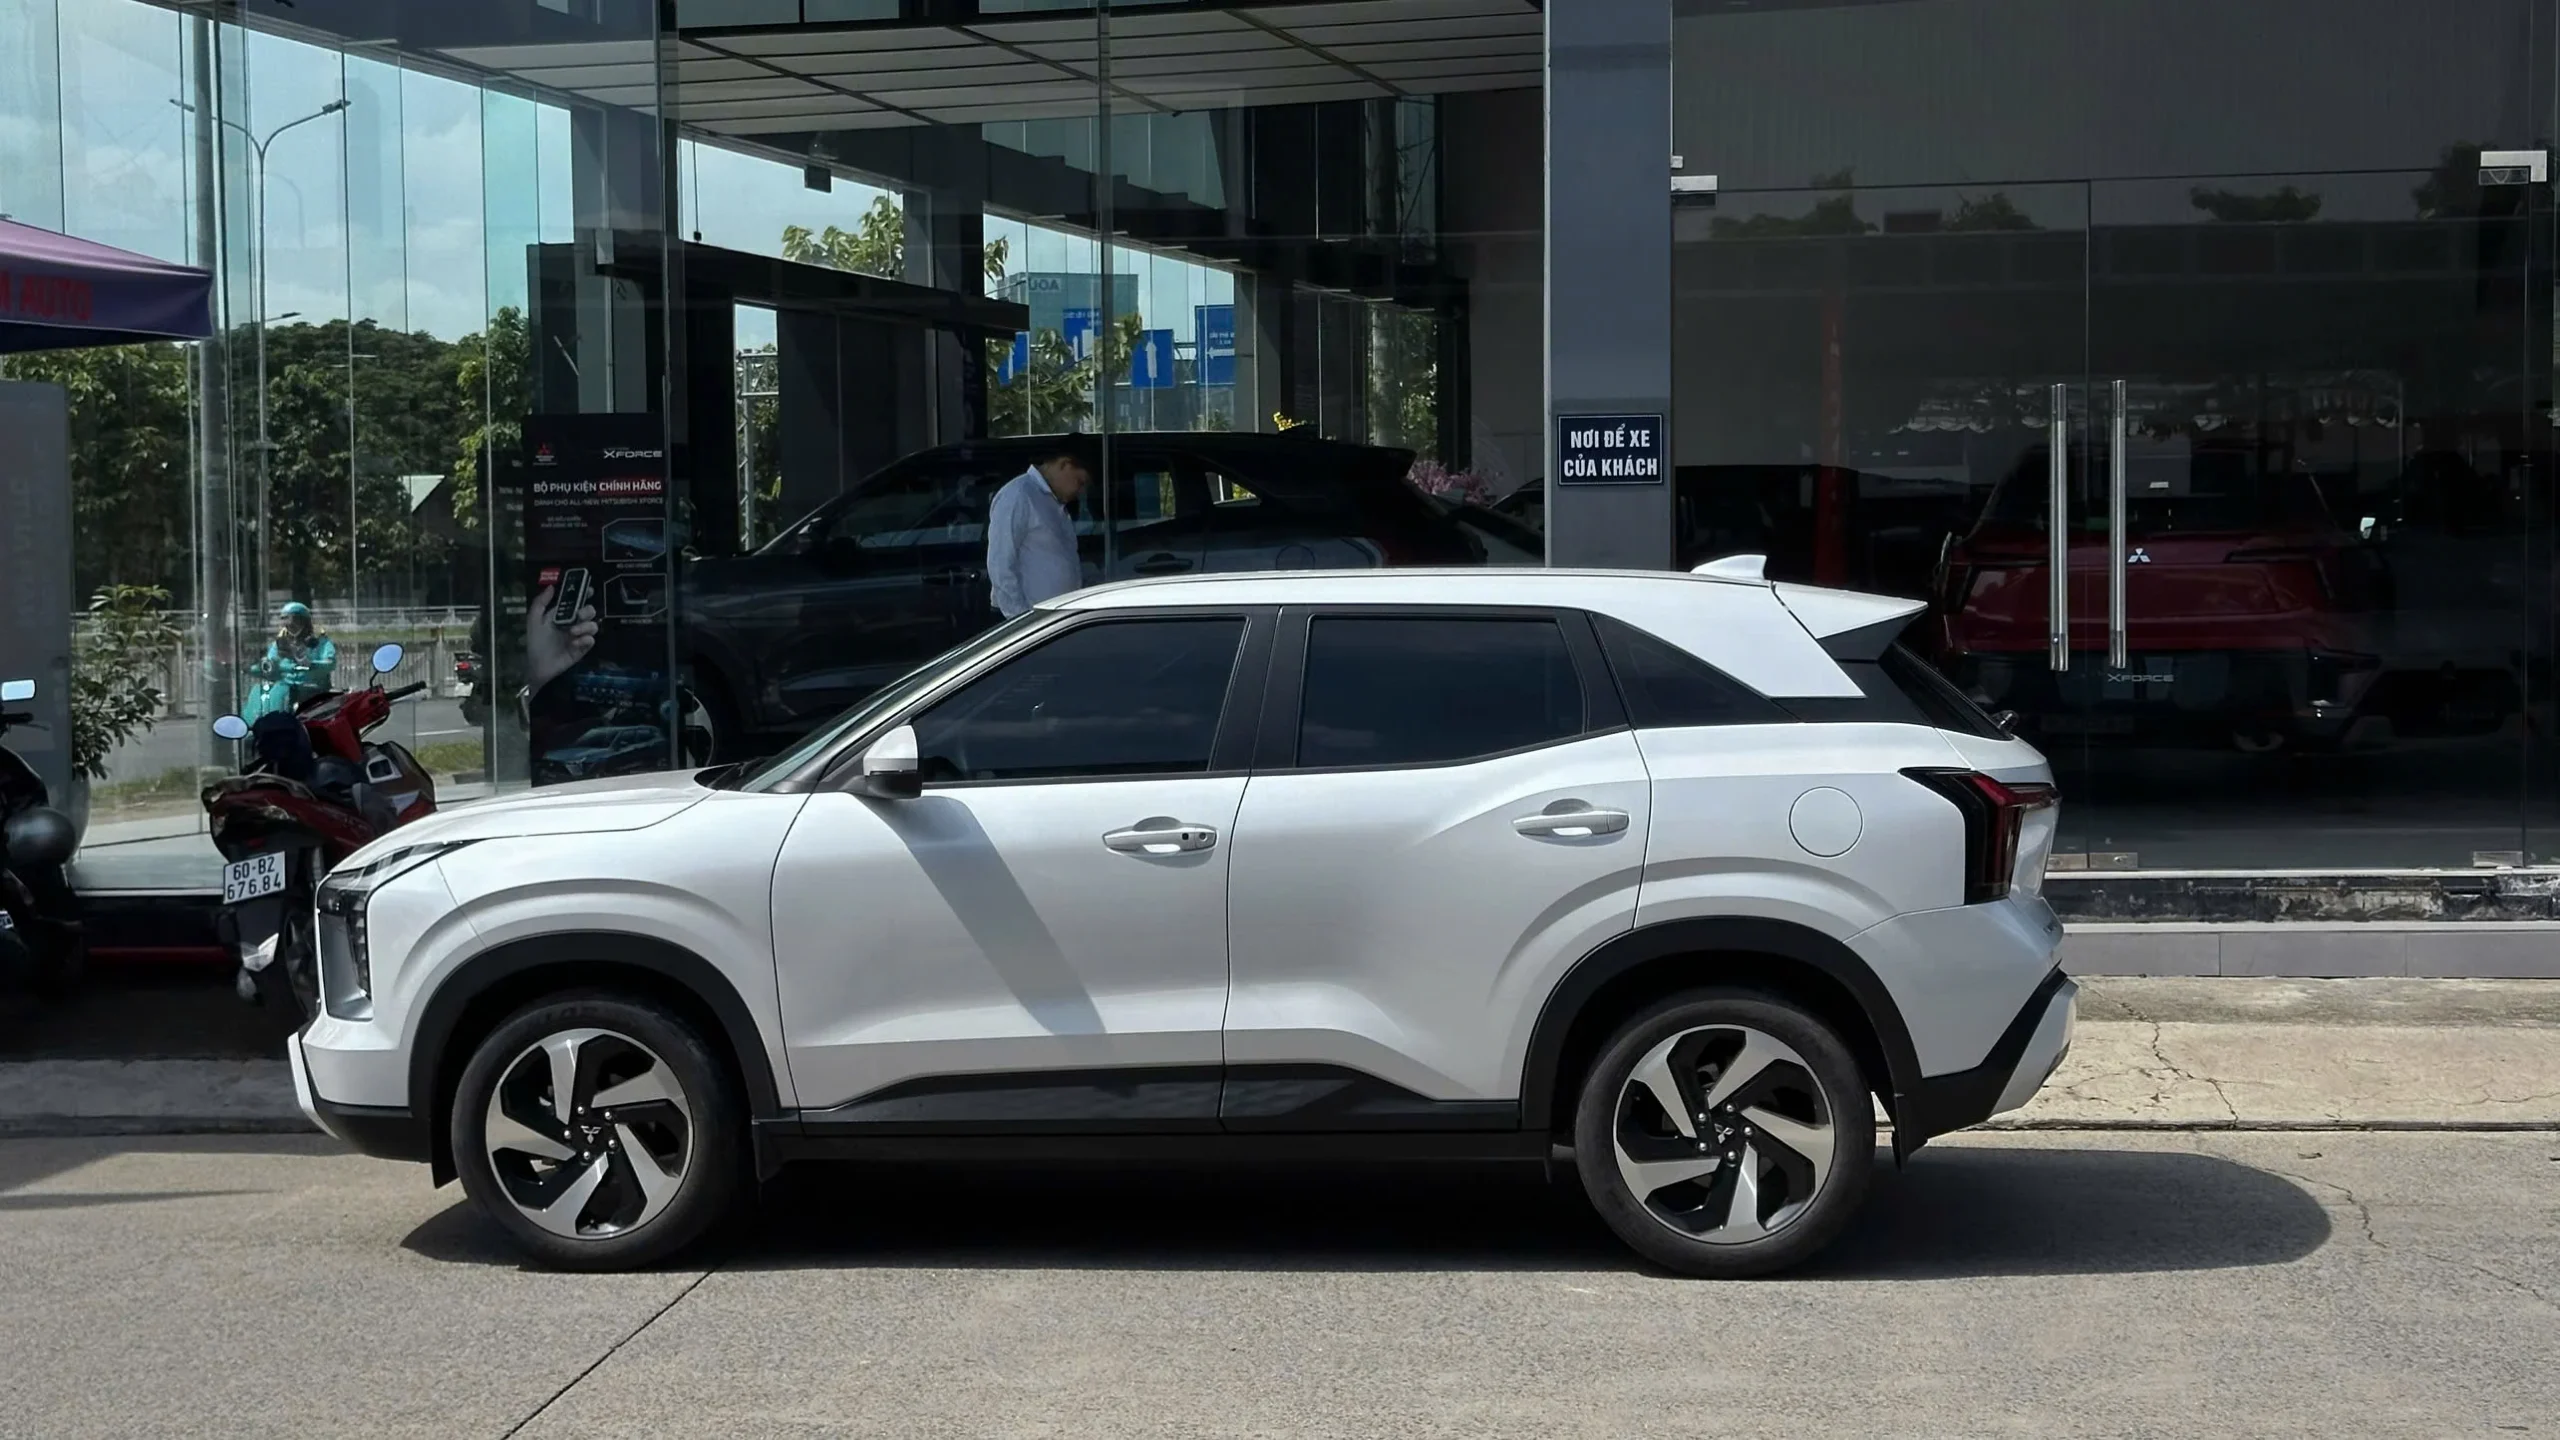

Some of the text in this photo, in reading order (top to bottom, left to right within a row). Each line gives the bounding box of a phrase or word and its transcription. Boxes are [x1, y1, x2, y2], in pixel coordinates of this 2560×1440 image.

[20, 275, 93, 320] AUTO
[1570, 423, 1651, 449] NƠI ĐỂ XE
[603, 450, 663, 459] XFORCE
[1563, 453, 1658, 477] CỦA KHÁCH
[533, 481, 548, 494] BỘ
[550, 482, 572, 494] PHỤ
[573, 479, 597, 494] KIỆN
[599, 479, 631, 492] CHÍNH
[2107, 673, 2174, 682] XFORCE
[228, 873, 281, 899] 676.84
